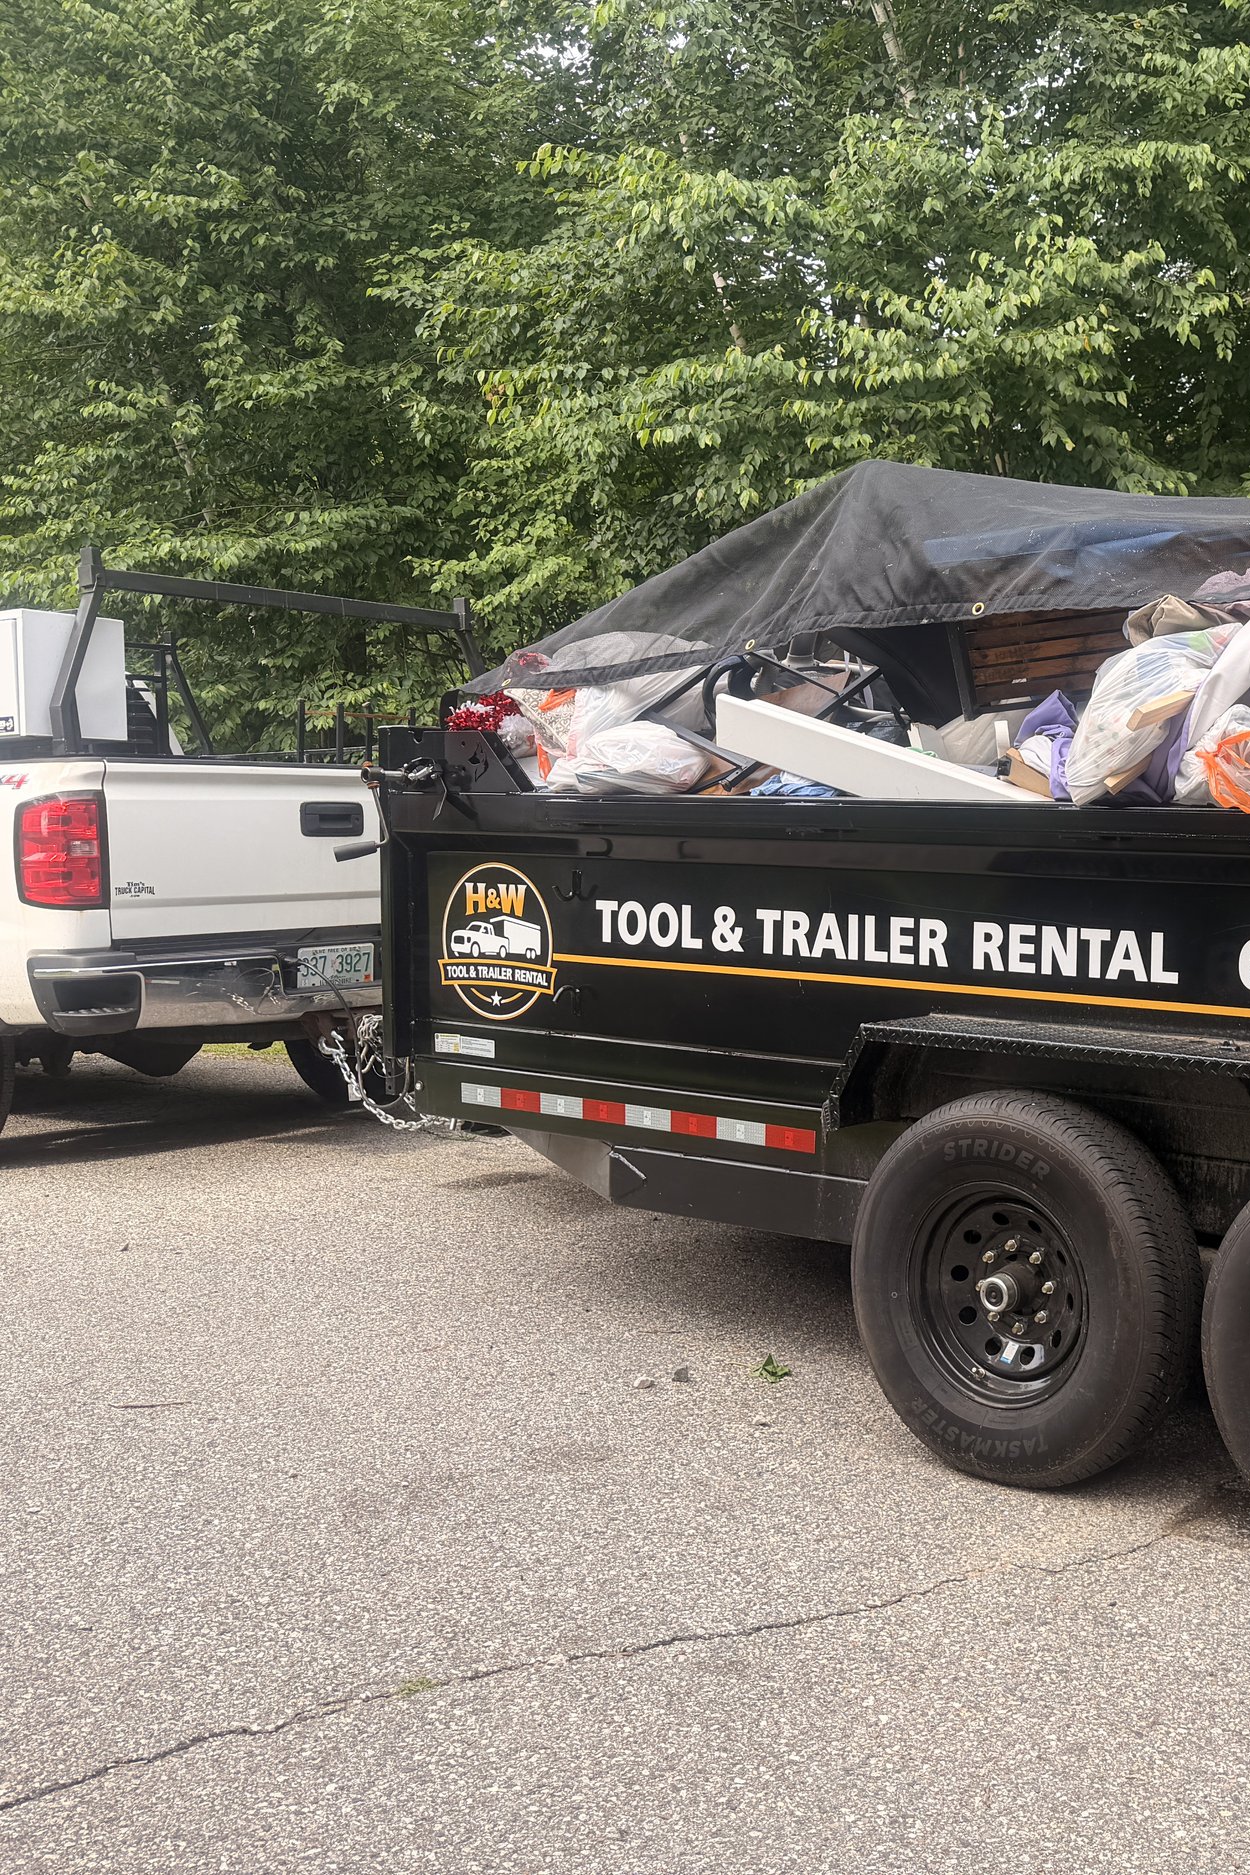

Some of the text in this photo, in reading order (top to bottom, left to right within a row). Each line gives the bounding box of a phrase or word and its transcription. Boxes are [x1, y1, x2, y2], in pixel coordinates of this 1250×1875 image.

[115, 886, 155, 895] TRUCK CAPITAL
[464, 881, 527, 918] H&W
[595, 899, 1179, 985] TOOL & TRAILER RENTAL
[336, 952, 370, 974] 3927
[446, 965, 548, 987] TOOL & TRAILER RENTAL
[942, 1137, 1051, 1181] STRIDER
[911, 1396, 1049, 1459] TASKMASTER
